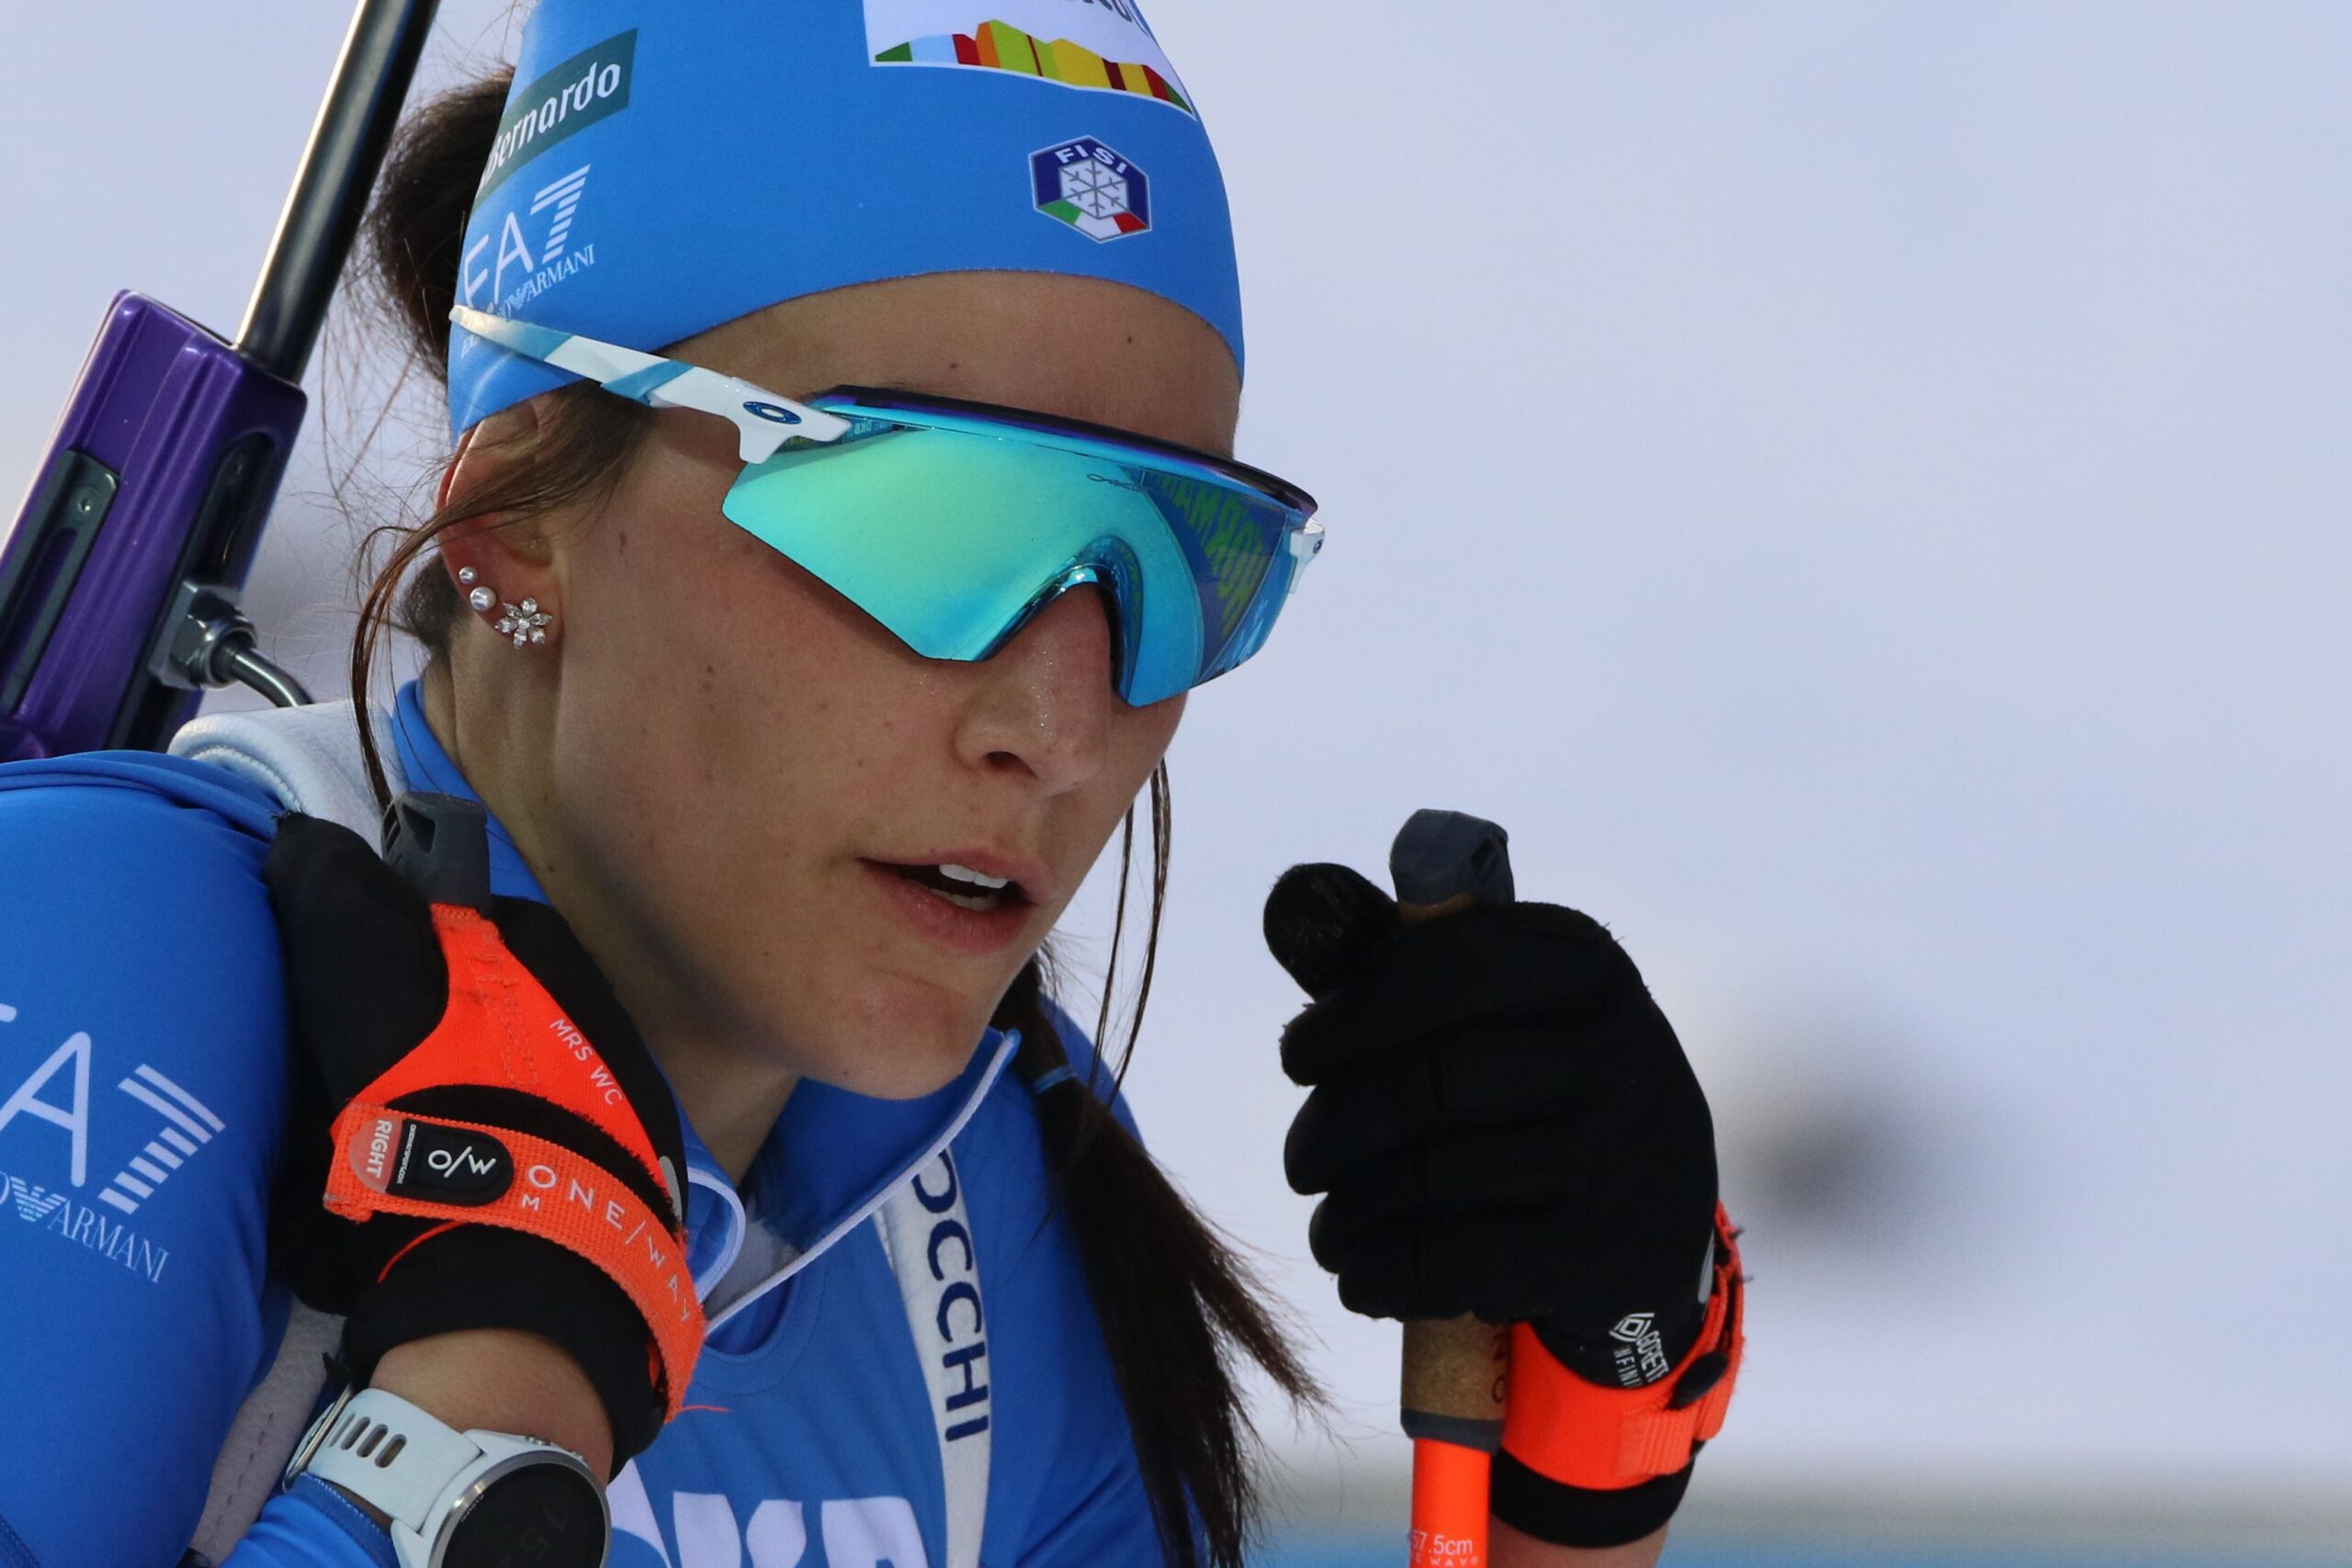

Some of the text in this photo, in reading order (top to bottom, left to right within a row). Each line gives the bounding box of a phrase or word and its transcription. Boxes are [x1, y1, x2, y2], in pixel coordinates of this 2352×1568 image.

[1054, 144, 1128, 175] FISI
[524, 243, 595, 303] ARMANI
[549, 1018, 594, 1063] MRS
[0, 1002, 226, 1215] A7
[367, 1119, 392, 1179] RIGHT
[522, 1195, 541, 1212] M
[47, 1200, 170, 1283] ARMANI
